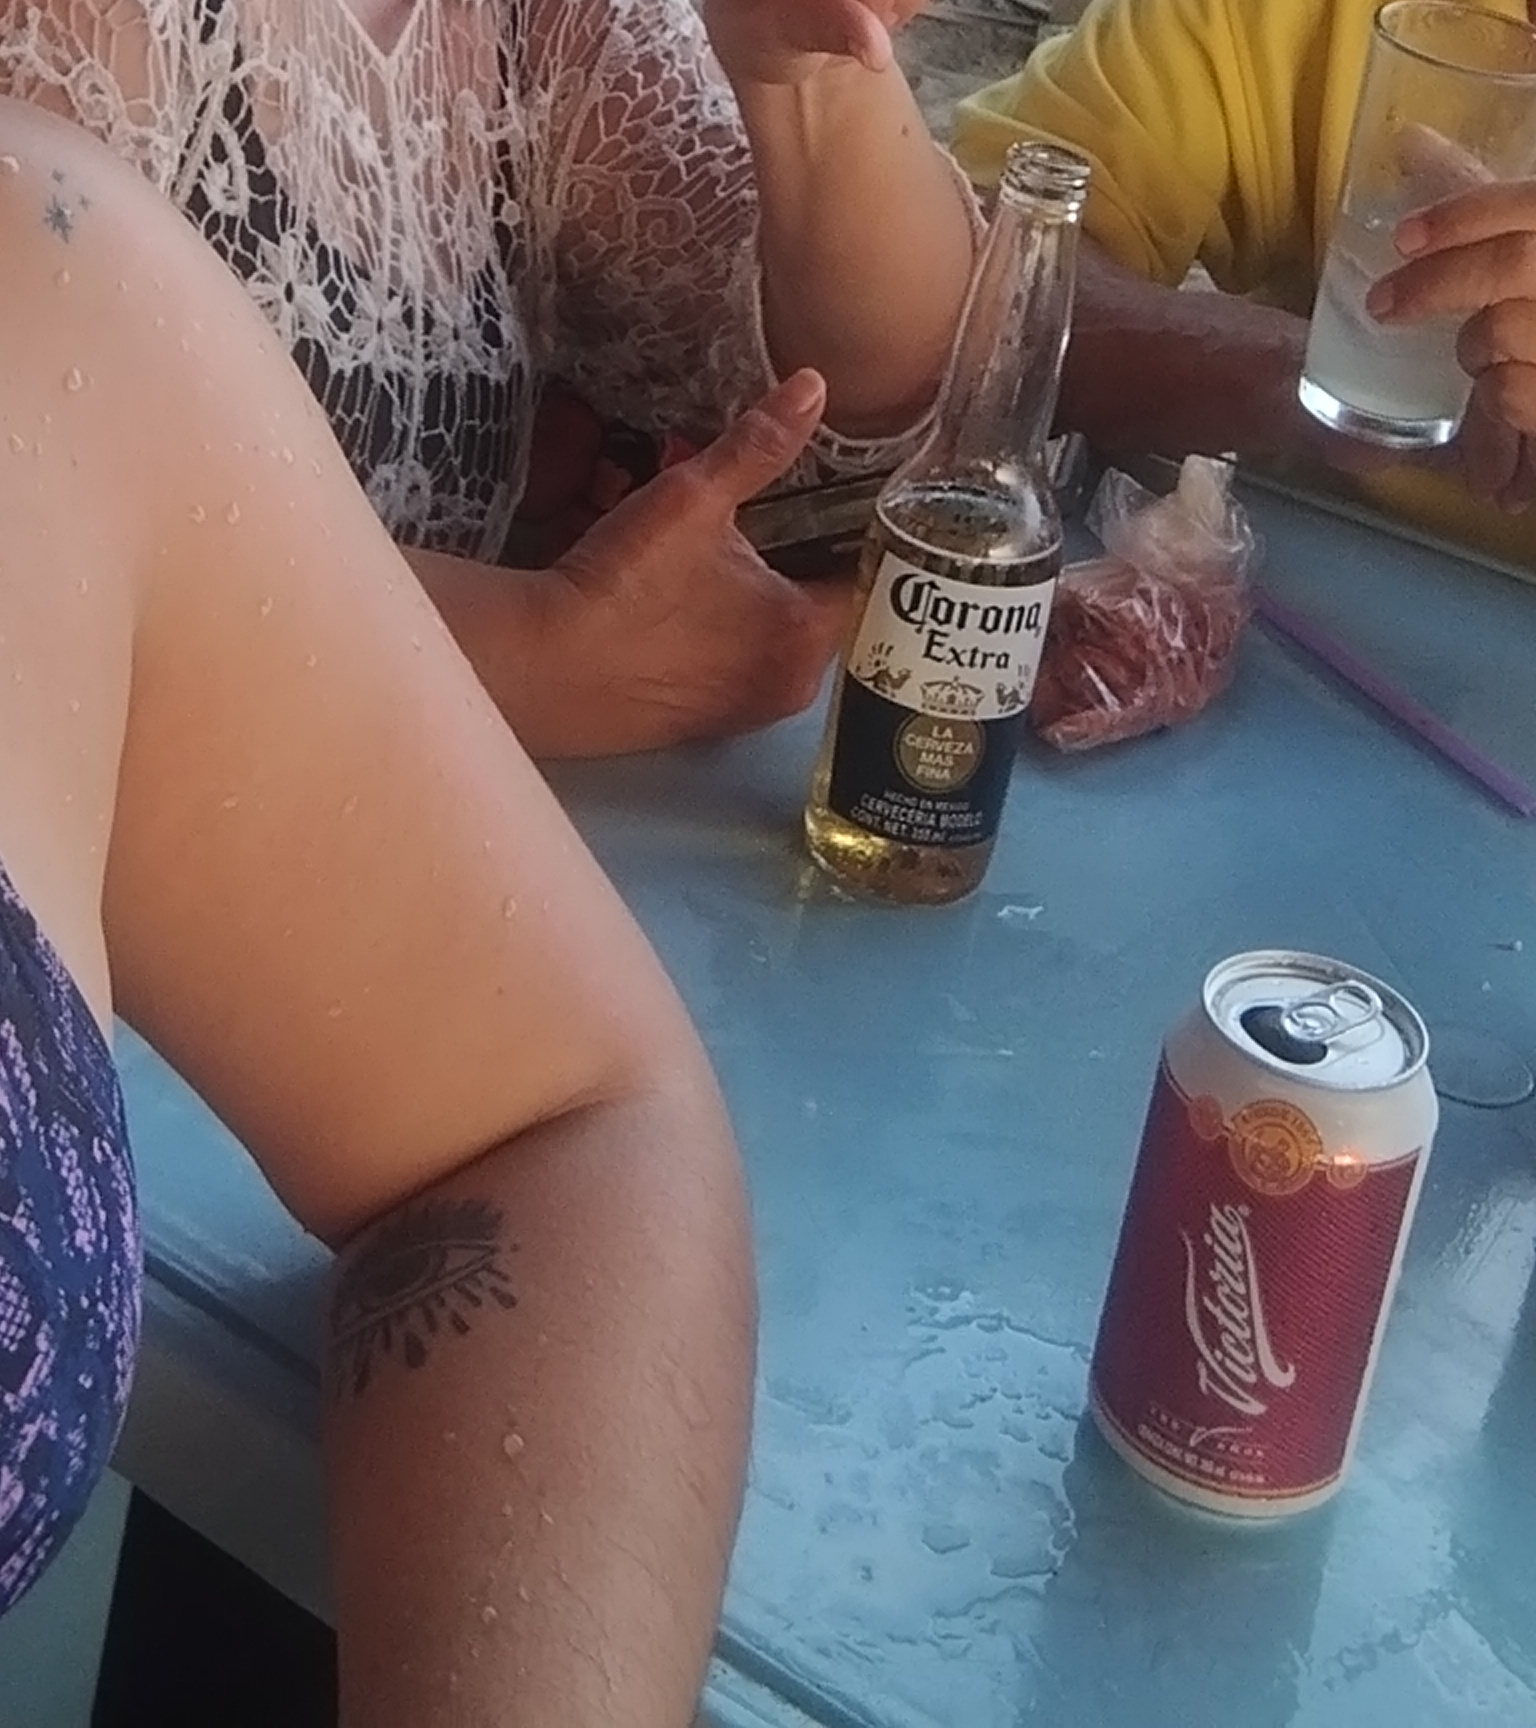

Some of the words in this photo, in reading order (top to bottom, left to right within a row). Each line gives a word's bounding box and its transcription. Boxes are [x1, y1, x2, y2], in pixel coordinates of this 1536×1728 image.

[890, 573, 1041, 634] Corona
[923, 629, 1010, 669] Extra
[904, 733, 973, 755] CERVEZA
[932, 725, 953, 739] LA
[916, 765, 951, 780] FINA
[1180, 1202, 1296, 1416] Victoria
